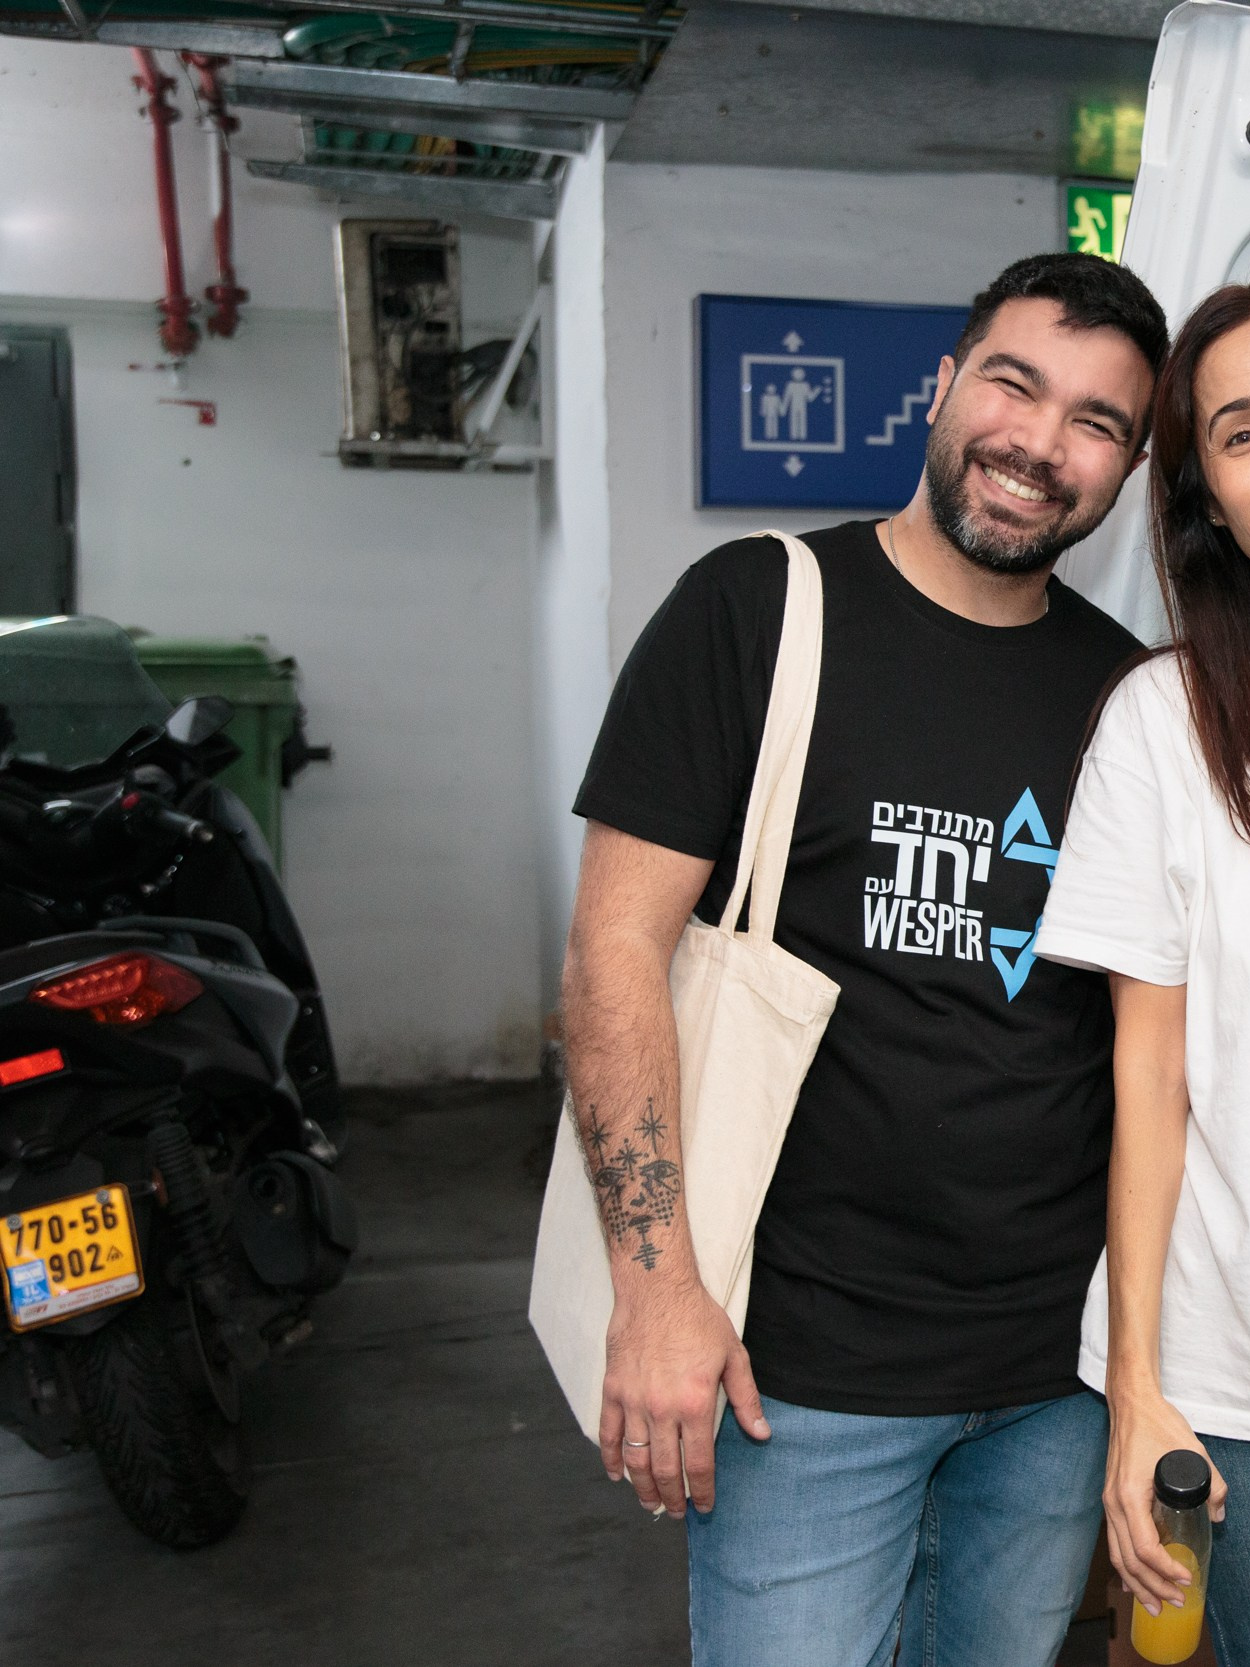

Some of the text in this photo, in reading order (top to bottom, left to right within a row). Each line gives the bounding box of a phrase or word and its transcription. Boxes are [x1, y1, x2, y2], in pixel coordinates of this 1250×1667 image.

[872, 801, 994, 844] מתנדבים
[864, 877, 894, 894] עם
[871, 829, 992, 906] יחד
[863, 894, 984, 961] WESPER
[9, 1202, 118, 1257] 770-56
[49, 1243, 105, 1283] 902
